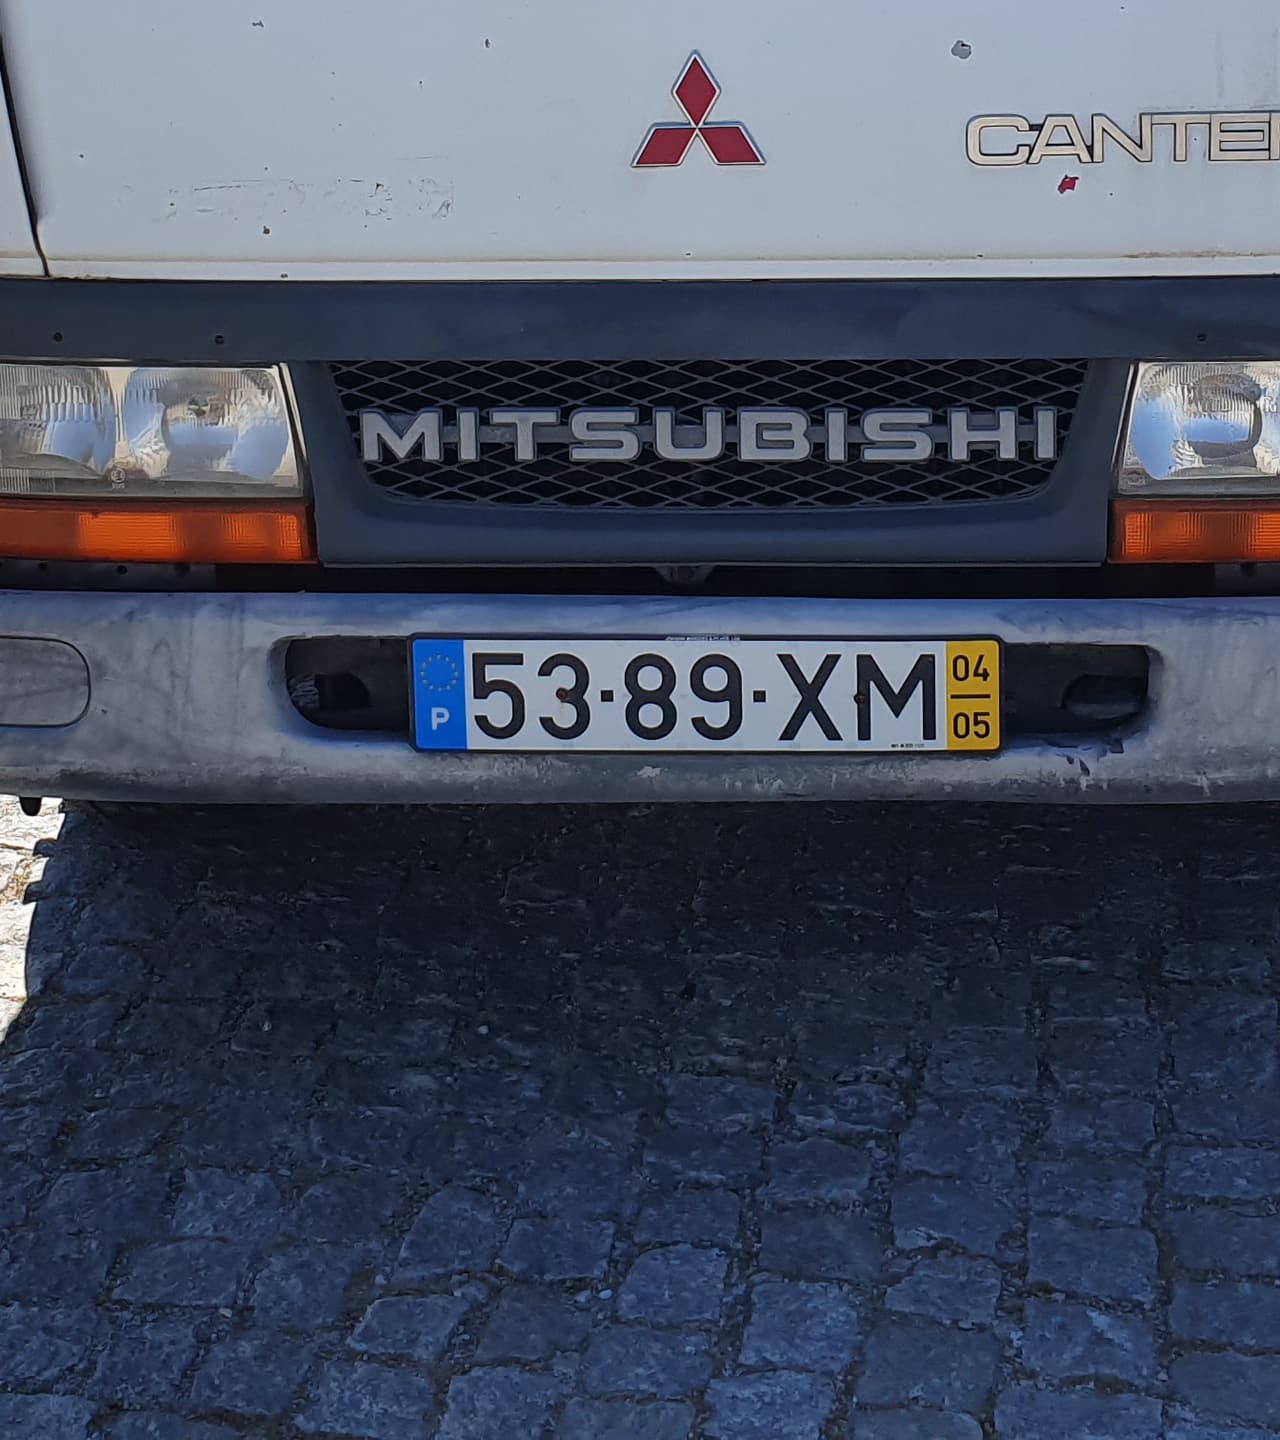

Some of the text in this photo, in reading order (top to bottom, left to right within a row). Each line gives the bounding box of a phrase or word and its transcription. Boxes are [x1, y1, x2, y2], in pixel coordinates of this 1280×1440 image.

[358, 406, 1060, 462] MITSUBISHI
[952, 654, 990, 682] 04
[431, 707, 450, 731] P
[952, 711, 990, 739] 05
